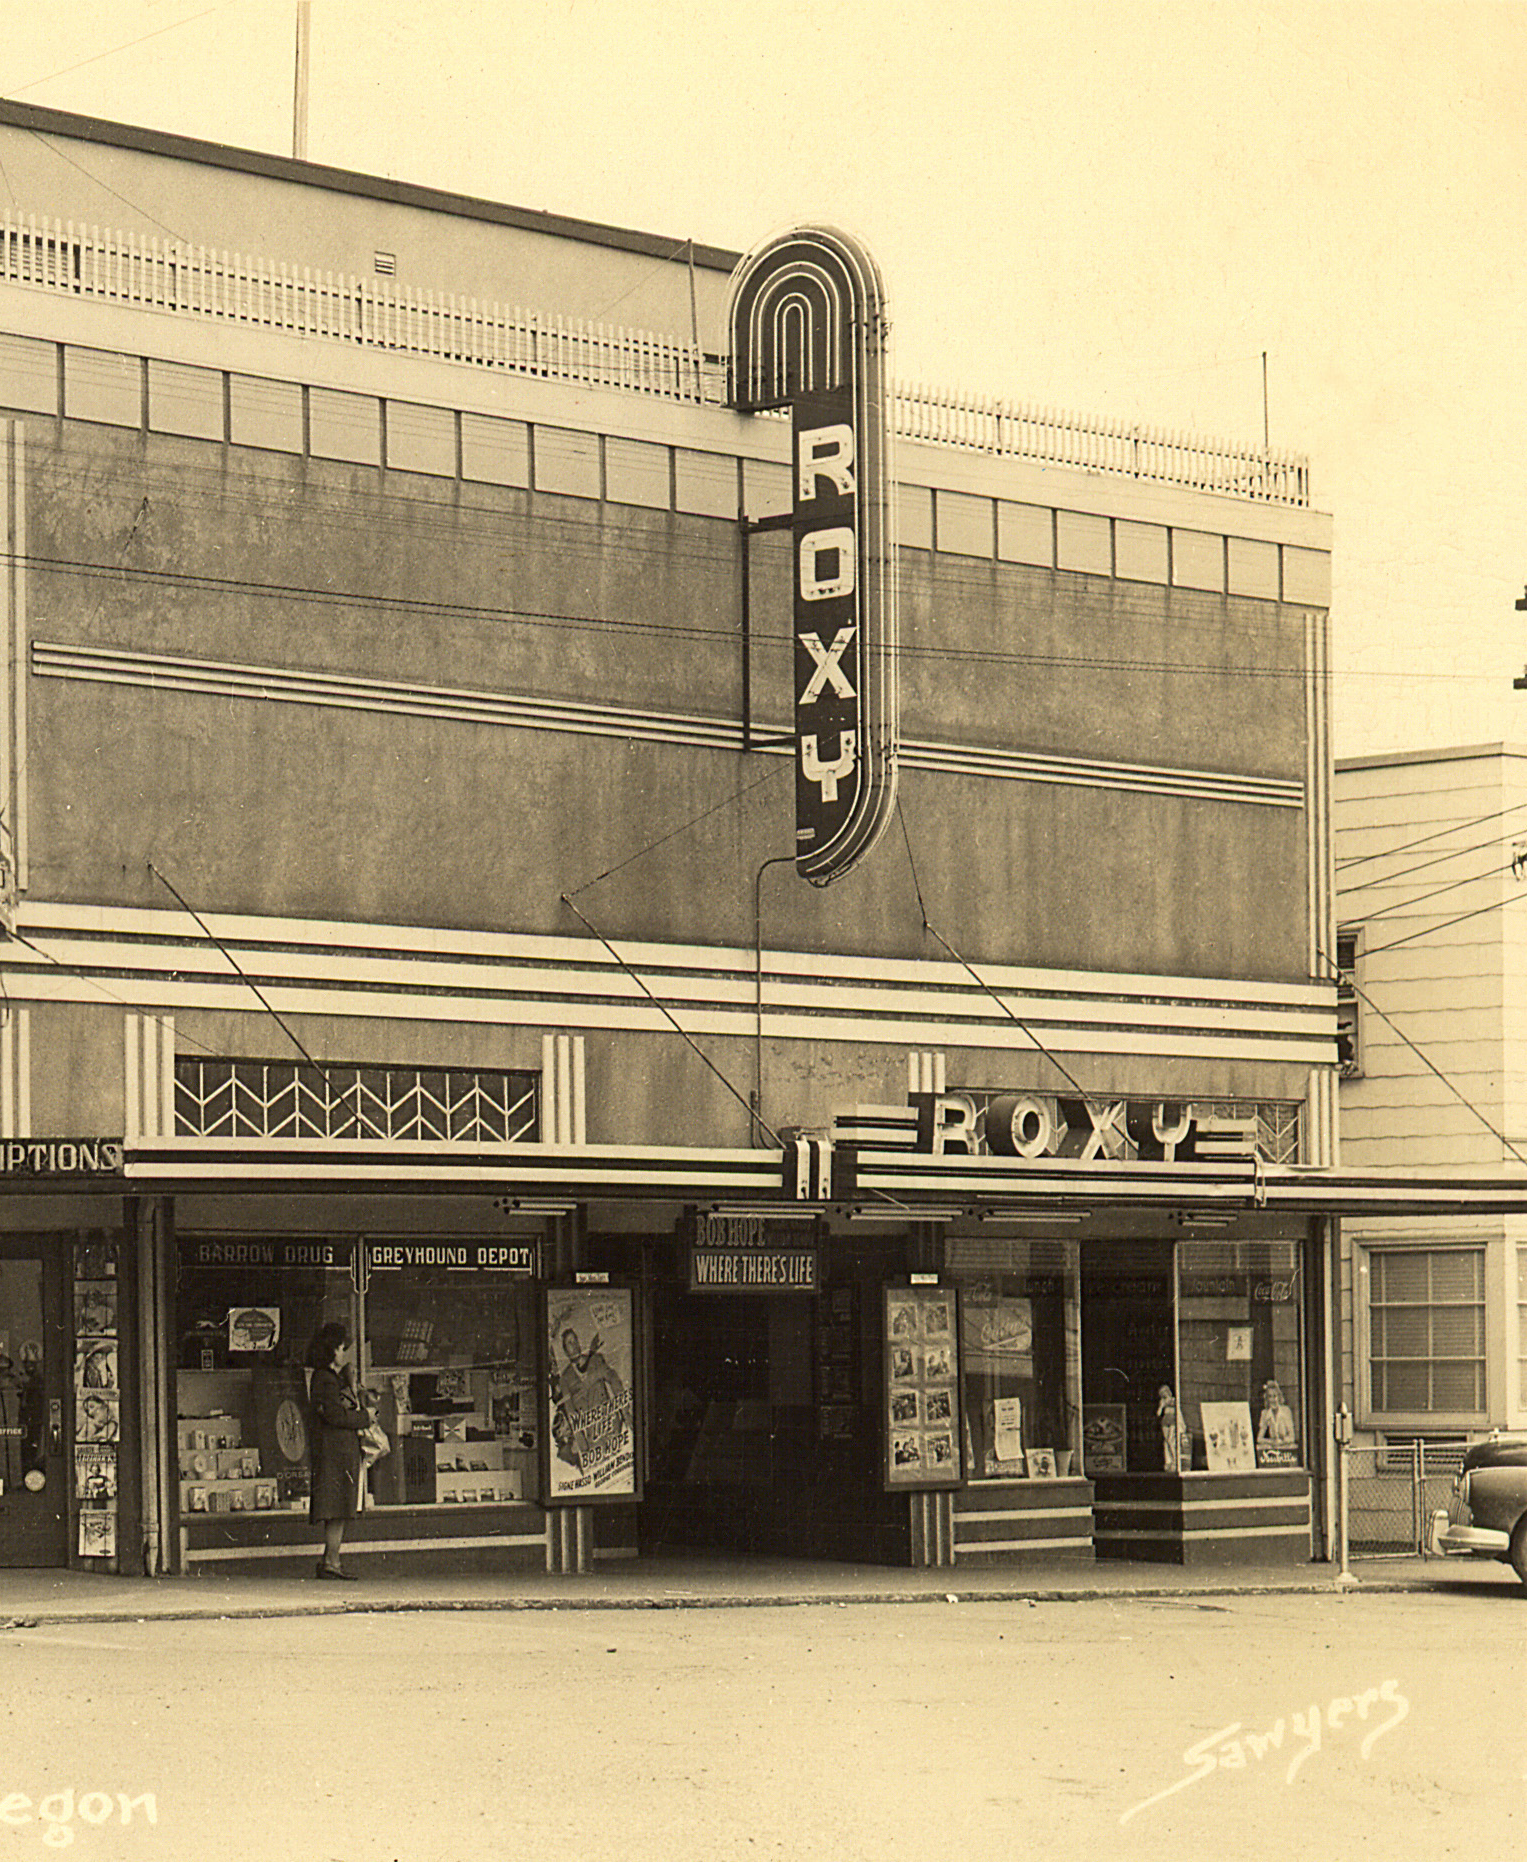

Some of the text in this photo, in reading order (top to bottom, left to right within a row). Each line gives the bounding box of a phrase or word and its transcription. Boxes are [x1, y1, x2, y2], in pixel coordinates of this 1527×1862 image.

[798, 423, 858, 803] ROXY
[935, 1092, 1193, 1162] ROXY
[696, 1215, 726, 1246] BOB
[727, 1217, 766, 1246] HOPE
[199, 1244, 333, 1264] BARROW DRUG
[372, 1246, 530, 1265] GREYHOUND DEPOT
[696, 1255, 813, 1283] WHERE THERE'S LIFE
[581, 1430, 629, 1468] BOB HOPE
